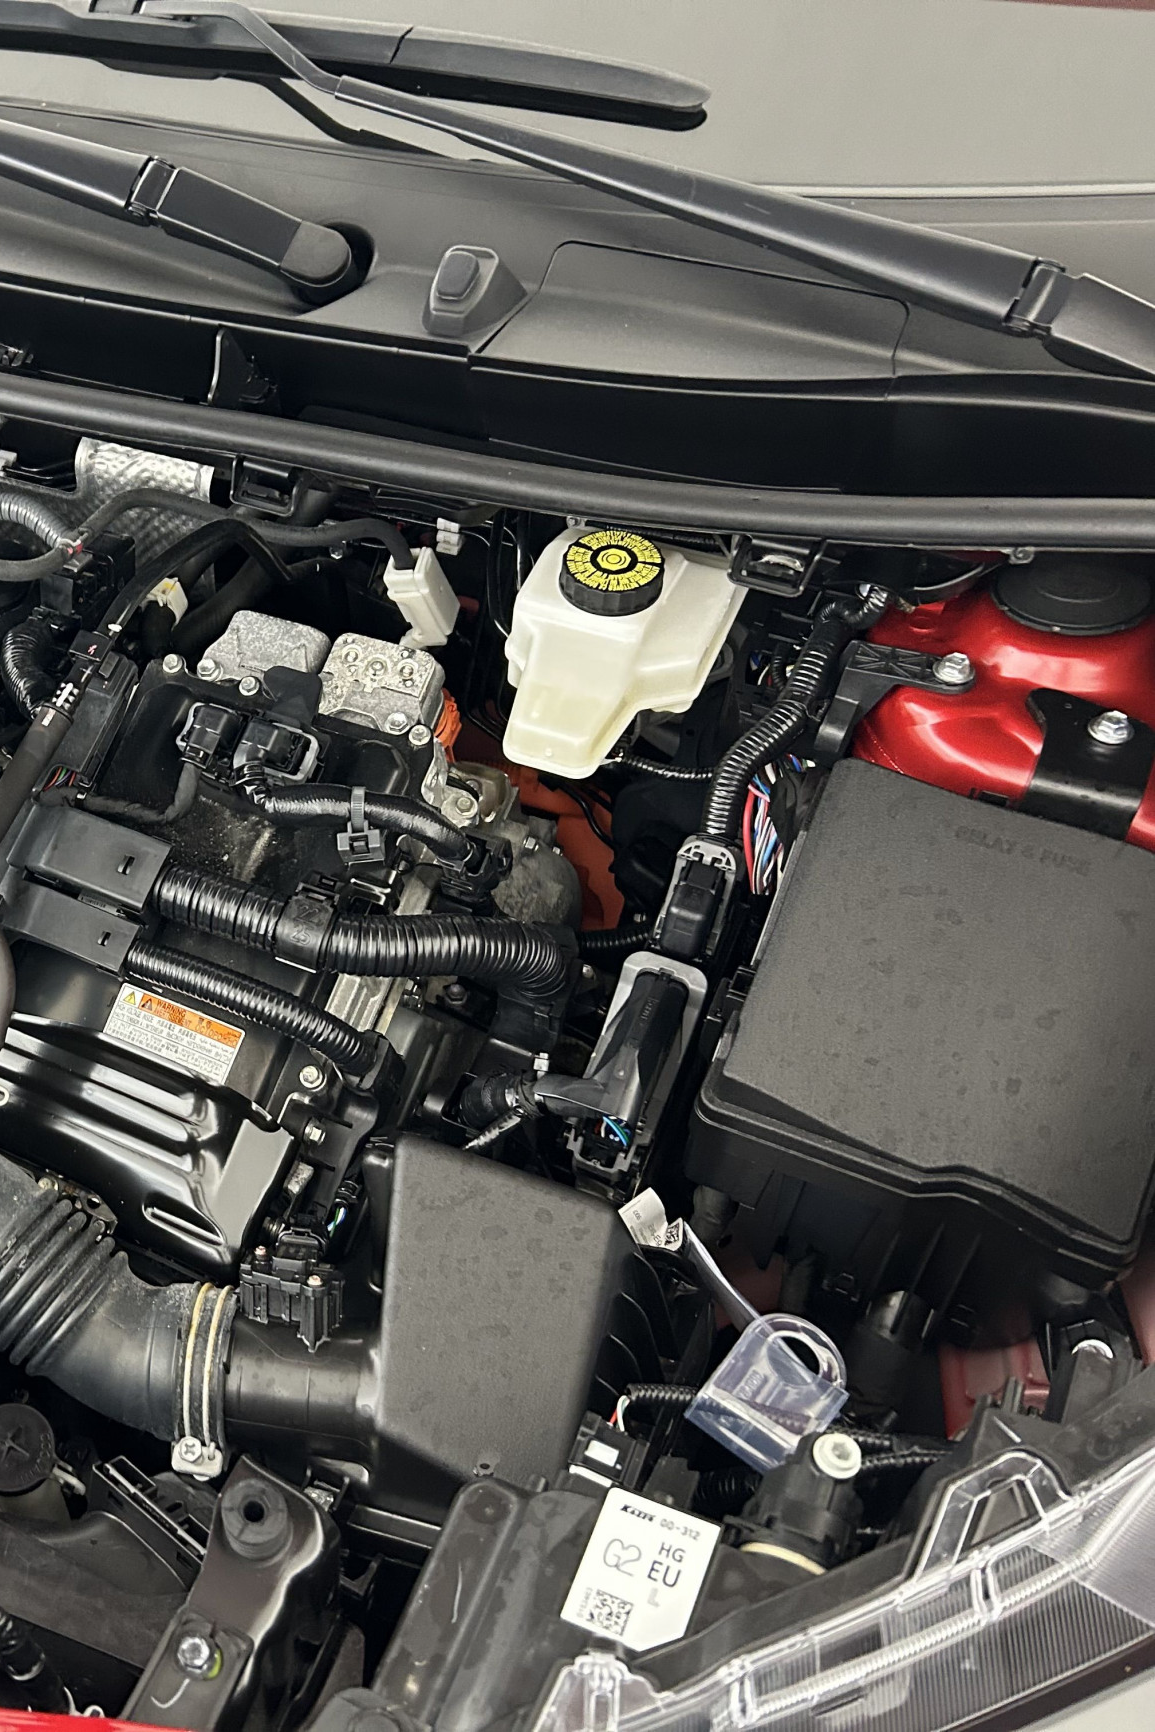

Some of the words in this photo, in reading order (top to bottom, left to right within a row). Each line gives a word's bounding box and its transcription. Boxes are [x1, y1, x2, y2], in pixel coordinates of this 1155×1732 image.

[156, 998, 187, 1018] WARNING
[657, 1542, 686, 1563] HG
[647, 1560, 682, 1588] EU
